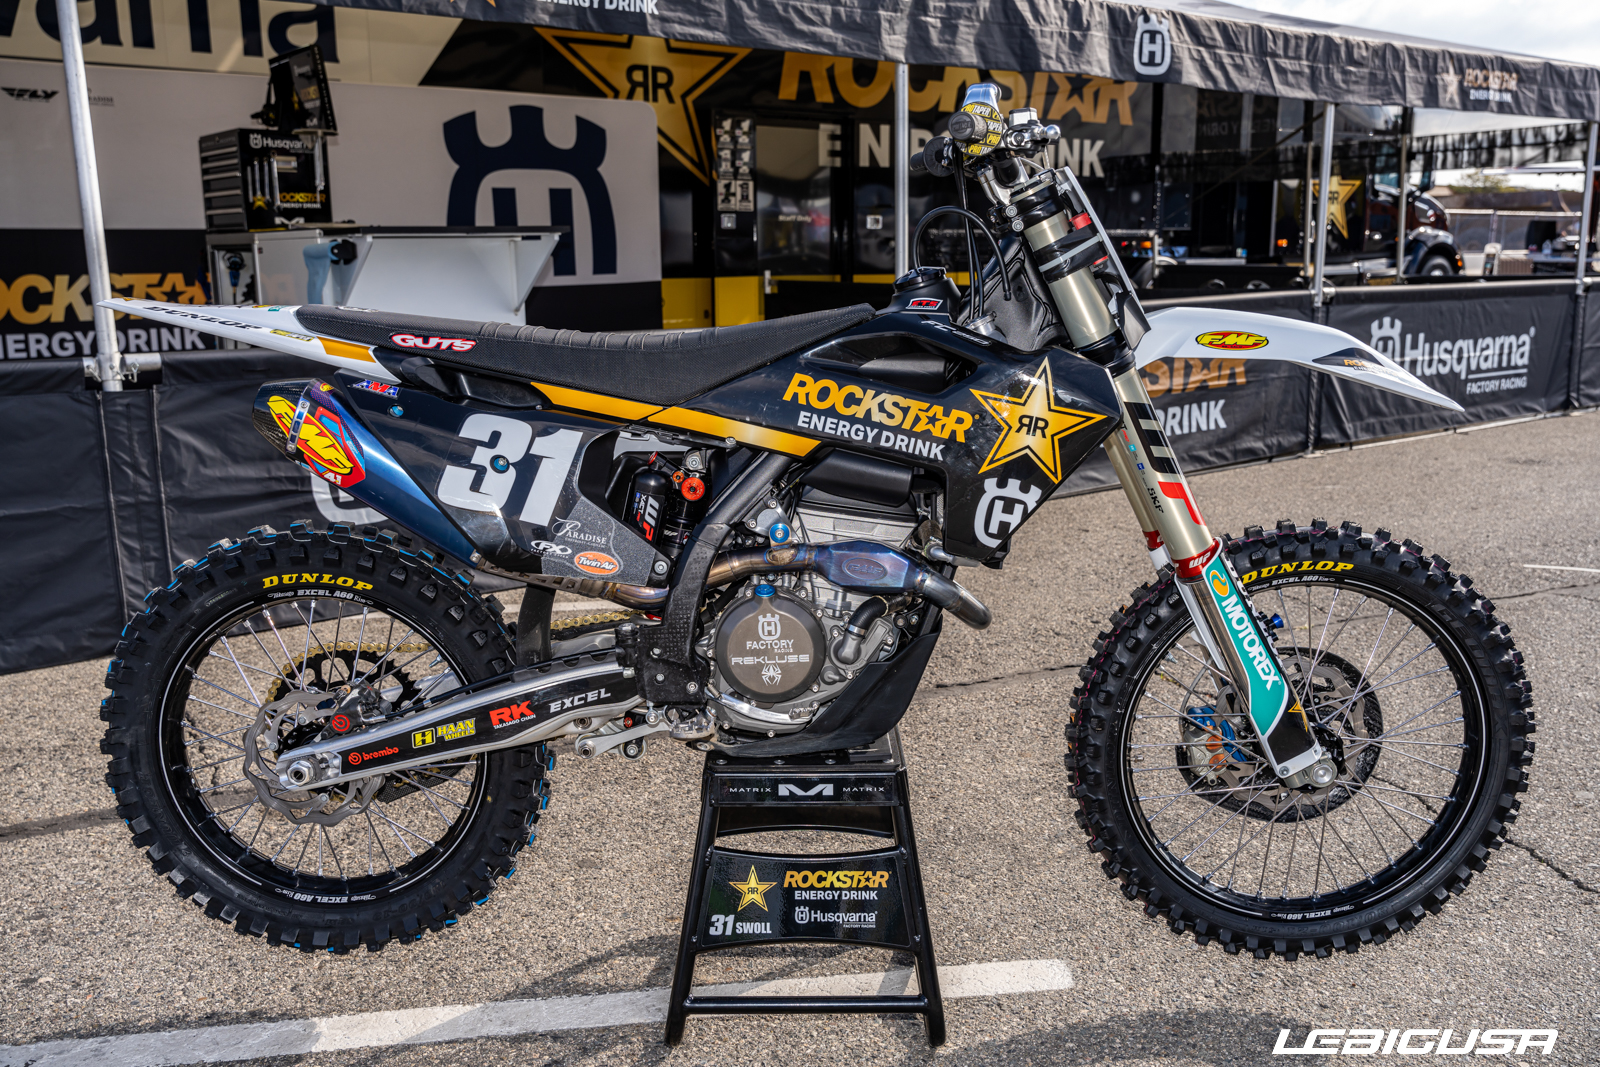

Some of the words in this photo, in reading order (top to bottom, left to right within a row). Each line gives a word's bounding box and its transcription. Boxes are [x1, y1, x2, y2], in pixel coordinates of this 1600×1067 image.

[0, 330, 96, 360] ERGY
[391, 334, 477, 352] GUTS
[1198, 333, 1267, 347] FMF
[1404, 331, 1531, 380] Husqvarna
[352, 379, 400, 398] AMA
[1466, 379, 1499, 395] FACTORY
[1500, 376, 1528, 392] RACING
[782, 372, 973, 443] ROCKSTAR
[797, 410, 882, 443] ENERGY
[880, 432, 946, 461] DRINK
[437, 413, 583, 527] 31
[1147, 487, 1165, 514] SKF
[578, 556, 602, 568] Twin
[600, 561, 617, 571] Air
[1188, 551, 1211, 568] WP
[262, 572, 374, 591] DUNLOP
[1241, 560, 1355, 585] DUNLOP
[1271, 576, 1301, 586] EXCEL
[297, 589, 332, 597] EXCEL
[333, 590, 355, 600] A60
[746, 639, 794, 650] FACTORY
[1221, 594, 1282, 691] MOTOREX
[731, 654, 810, 665] REKLUSE
[549, 690, 611, 713] EXCEL
[488, 700, 535, 727] RK
[493, 719, 520, 730] TAKASAGO
[520, 713, 536, 722] CHAIN
[436, 718, 476, 737] HAAN
[444, 728, 476, 741] WHEELS
[362, 746, 399, 762] brembo
[783, 870, 890, 889] ROCKSTAR
[315, 895, 349, 904] EXCEL
[794, 890, 840, 900] ENERGY
[841, 890, 878, 900] DRINK
[709, 914, 736, 936] 31
[735, 922, 772, 935] SWOLL
[811, 910, 876, 924] Husqvarna
